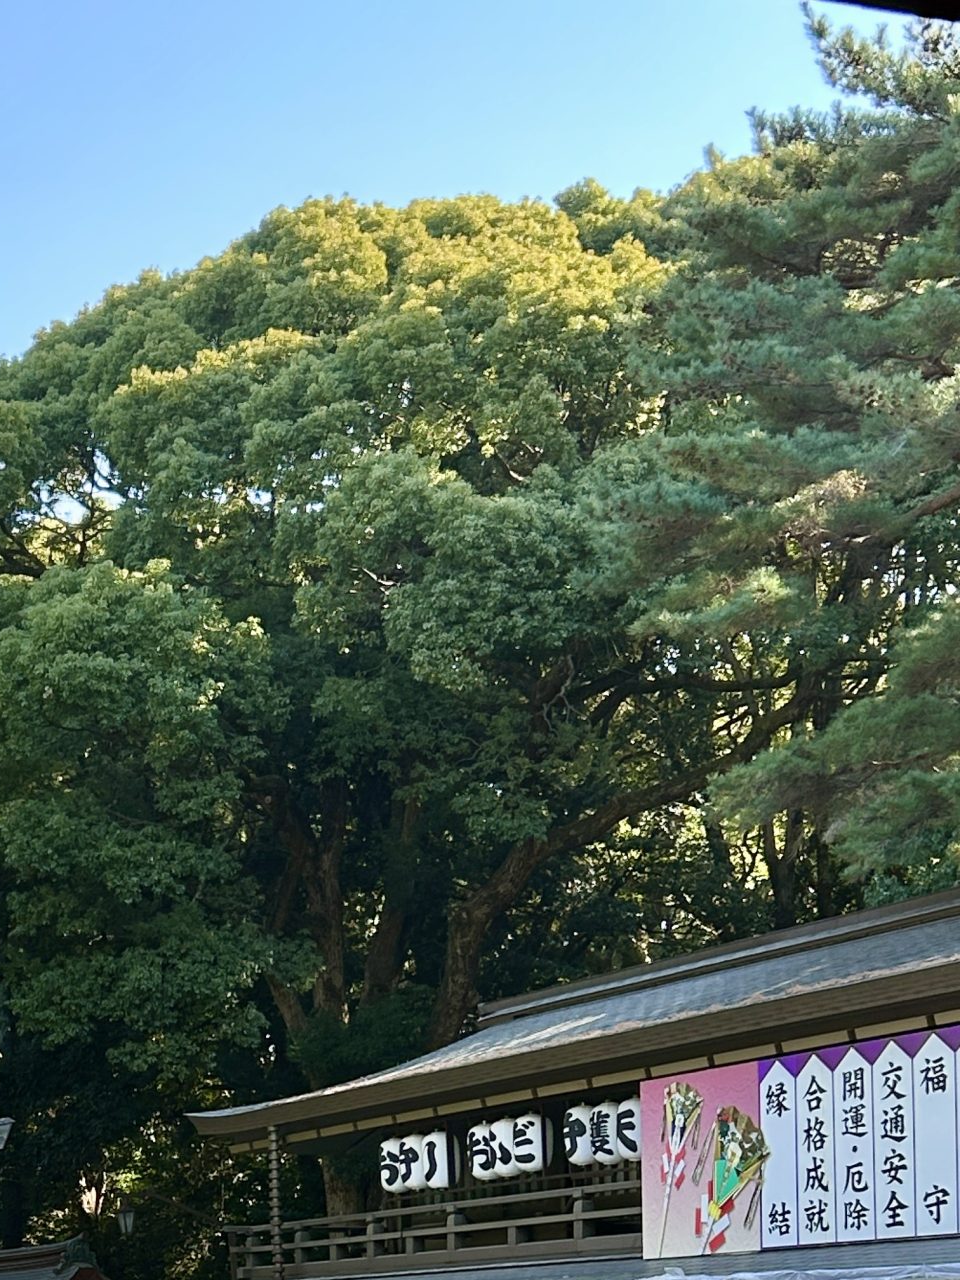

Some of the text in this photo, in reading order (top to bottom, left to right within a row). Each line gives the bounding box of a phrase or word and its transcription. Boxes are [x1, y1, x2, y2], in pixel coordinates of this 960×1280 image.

[765, 1081, 791, 1236] 縁結
[802, 1074, 830, 1234] 合格成就
[840, 1066, 870, 1231] 開運・厄除
[879, 1061, 909, 1228] 交通安全
[920, 1056, 951, 1225] 福守
